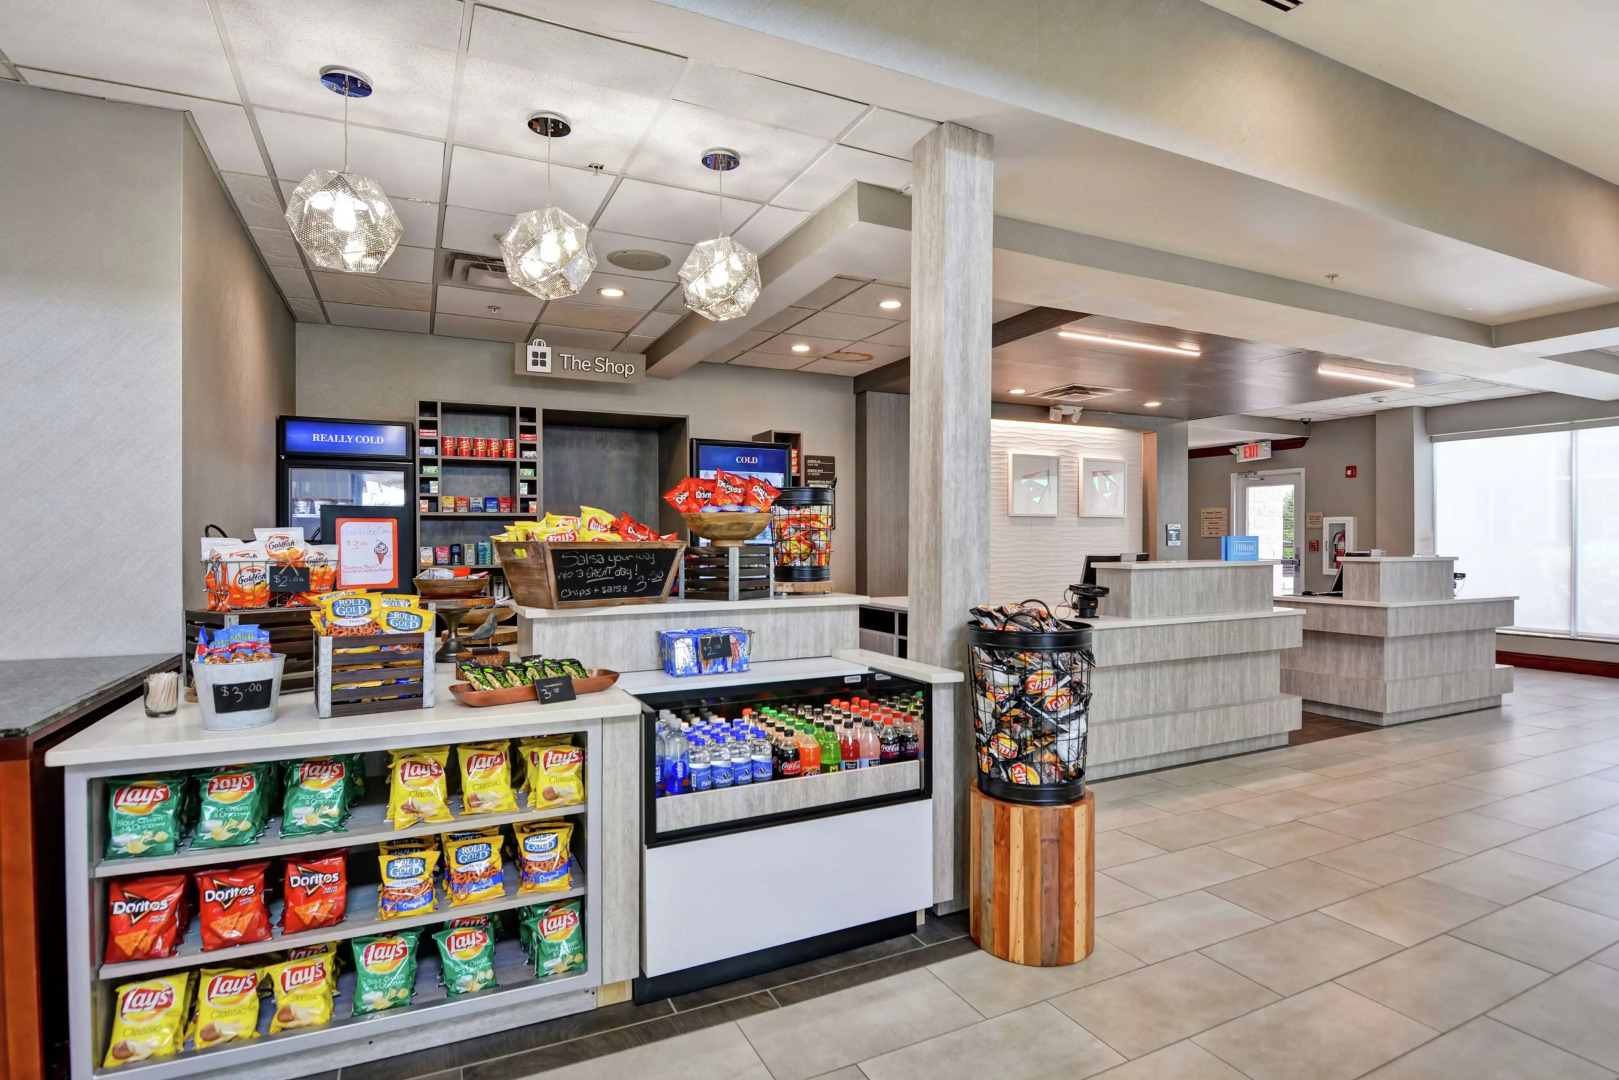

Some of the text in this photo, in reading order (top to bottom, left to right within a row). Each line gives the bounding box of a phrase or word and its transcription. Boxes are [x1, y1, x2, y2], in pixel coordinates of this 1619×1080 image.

[559, 353, 635, 378] The Shop
[312, 433, 384, 445] REALLY COLD
[1243, 444, 1259, 459] EXIT
[736, 456, 758, 464] COLD
[268, 540, 295, 550] Goldfish
[561, 551, 655, 568] Salsa your way
[238, 573, 266, 584] Goldfish
[273, 575, 304, 587] $2.00
[602, 584, 628, 594] salsa
[339, 598, 366, 606] ROLD
[336, 605, 369, 615] GOLD
[394, 611, 418, 621] ROLD
[390, 619, 420, 628] GOLD
[220, 683, 262, 703] $3.00
[549, 774, 578, 784] Classic
[472, 780, 502, 791] Classic
[461, 844, 487, 855] ROLD
[526, 842, 555, 851] GOLD
[394, 858, 421, 867] ROLD
[459, 851, 488, 863] GOLD
[389, 866, 424, 877] GOLD
[289, 872, 339, 889] Doritos
[205, 884, 255, 902] Doritos
[112, 899, 169, 916] Doritos
[211, 1007, 246, 1019] Classic
[123, 1025, 162, 1037] Classic
